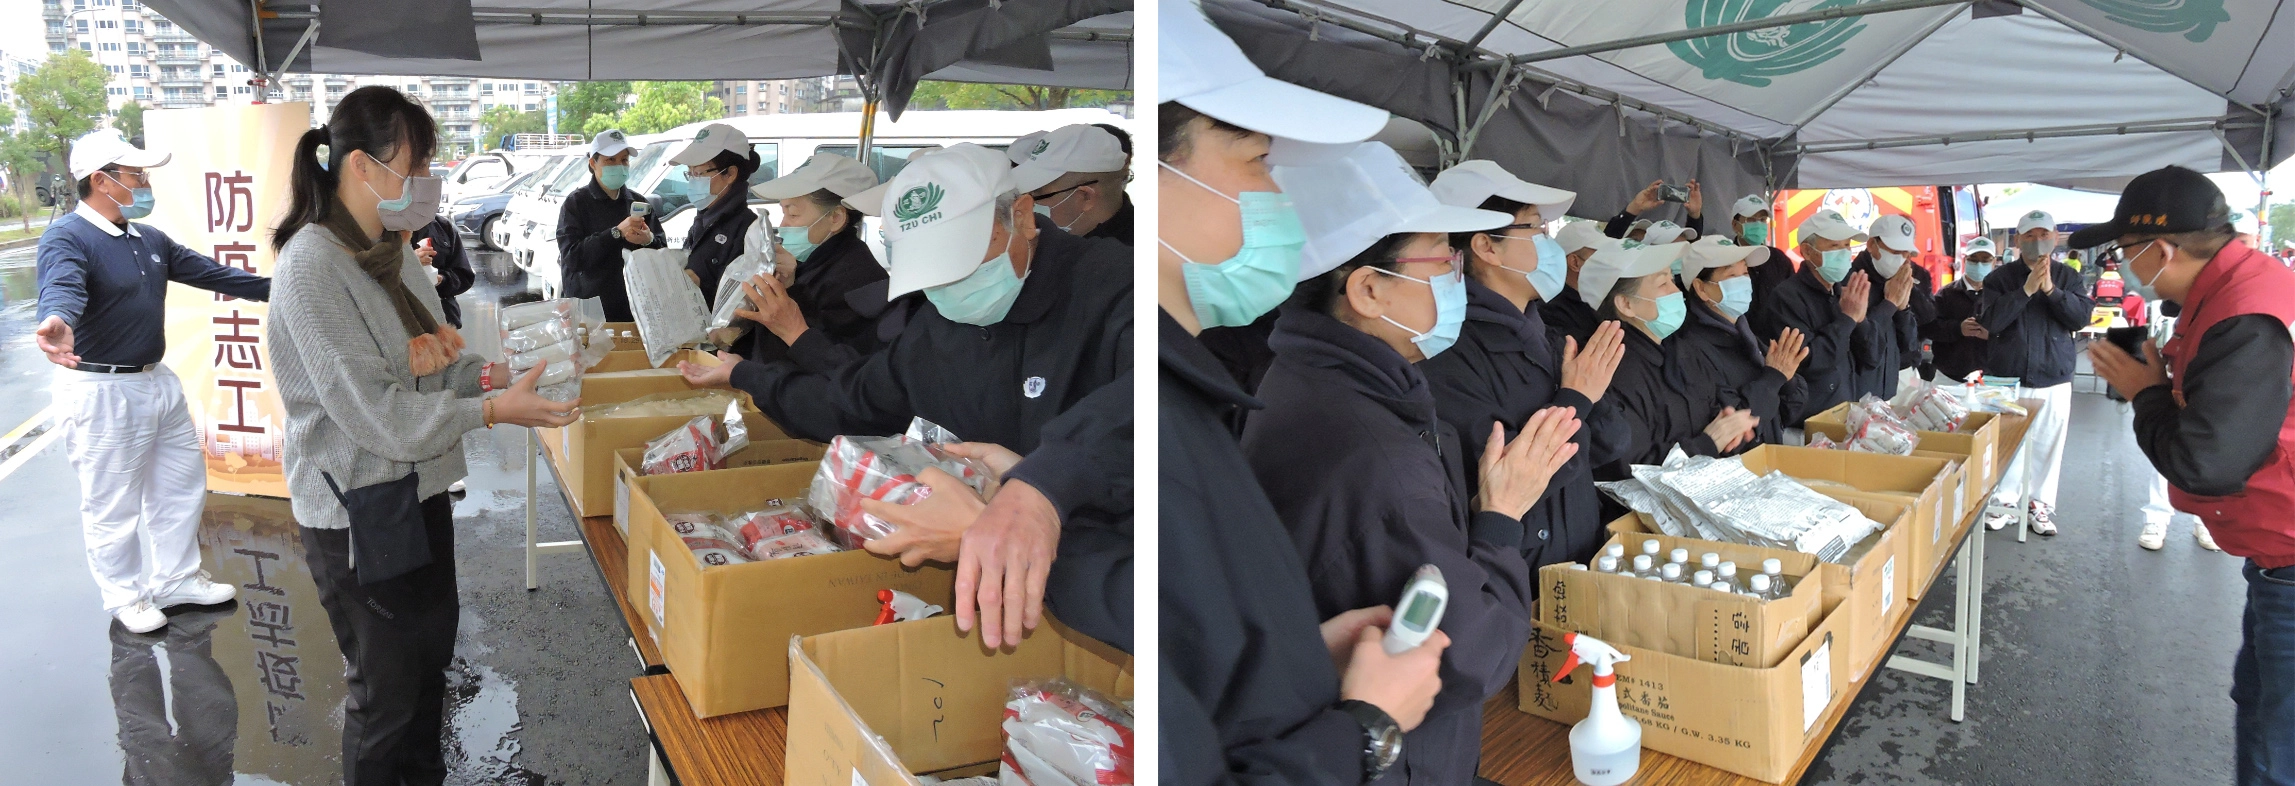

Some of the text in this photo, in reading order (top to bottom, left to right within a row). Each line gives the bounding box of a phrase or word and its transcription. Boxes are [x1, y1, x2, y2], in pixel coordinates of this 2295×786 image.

[900, 212, 942, 232] TZU CHI
[205, 170, 265, 434] 防疫志工
[1731, 612, 1750, 667] 這是
[1616, 674, 1664, 691] EM# 1413
[1617, 687, 1670, 710] 式番茄
[1618, 702, 1675, 722] politane Sauce
[1656, 721, 1670, 731] KG
[1681, 727, 1703, 740] G.W.
[1707, 733, 1731, 746] 3.35
[1735, 739, 1751, 749] KG
